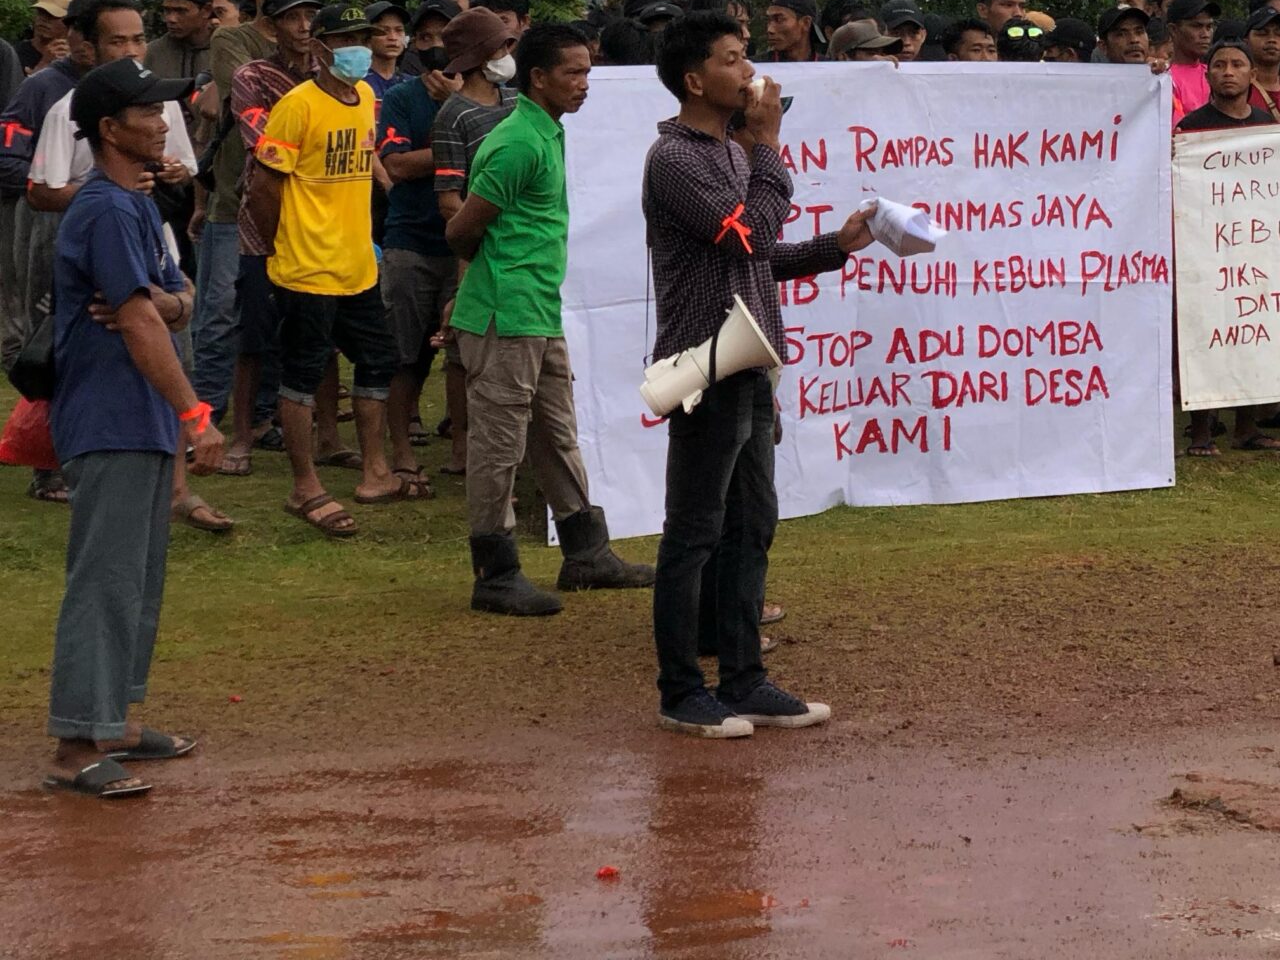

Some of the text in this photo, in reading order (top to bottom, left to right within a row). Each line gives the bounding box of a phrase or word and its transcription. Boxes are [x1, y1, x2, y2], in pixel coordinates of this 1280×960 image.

[327, 128, 357, 152] LAKI
[848, 125, 954, 172] RAMPAS
[974, 131, 1029, 169] HAK
[1040, 113, 1121, 166] KAMI
[1203, 148, 1274, 170] CUKUP
[1031, 193, 1112, 230] JAYA
[839, 250, 957, 298] PENUHI
[973, 257, 1066, 294] KEBUN
[1080, 250, 1168, 296] PLASMA
[1216, 263, 1268, 291] JIKA
[783, 320, 1103, 367] STOP ADU DOMBA
[1209, 323, 1270, 349] ANDA
[798, 372, 911, 421] KELUAR
[921, 370, 1008, 409] DARI
[1024, 365, 1109, 407] DESA
[832, 415, 951, 461] KAMI
